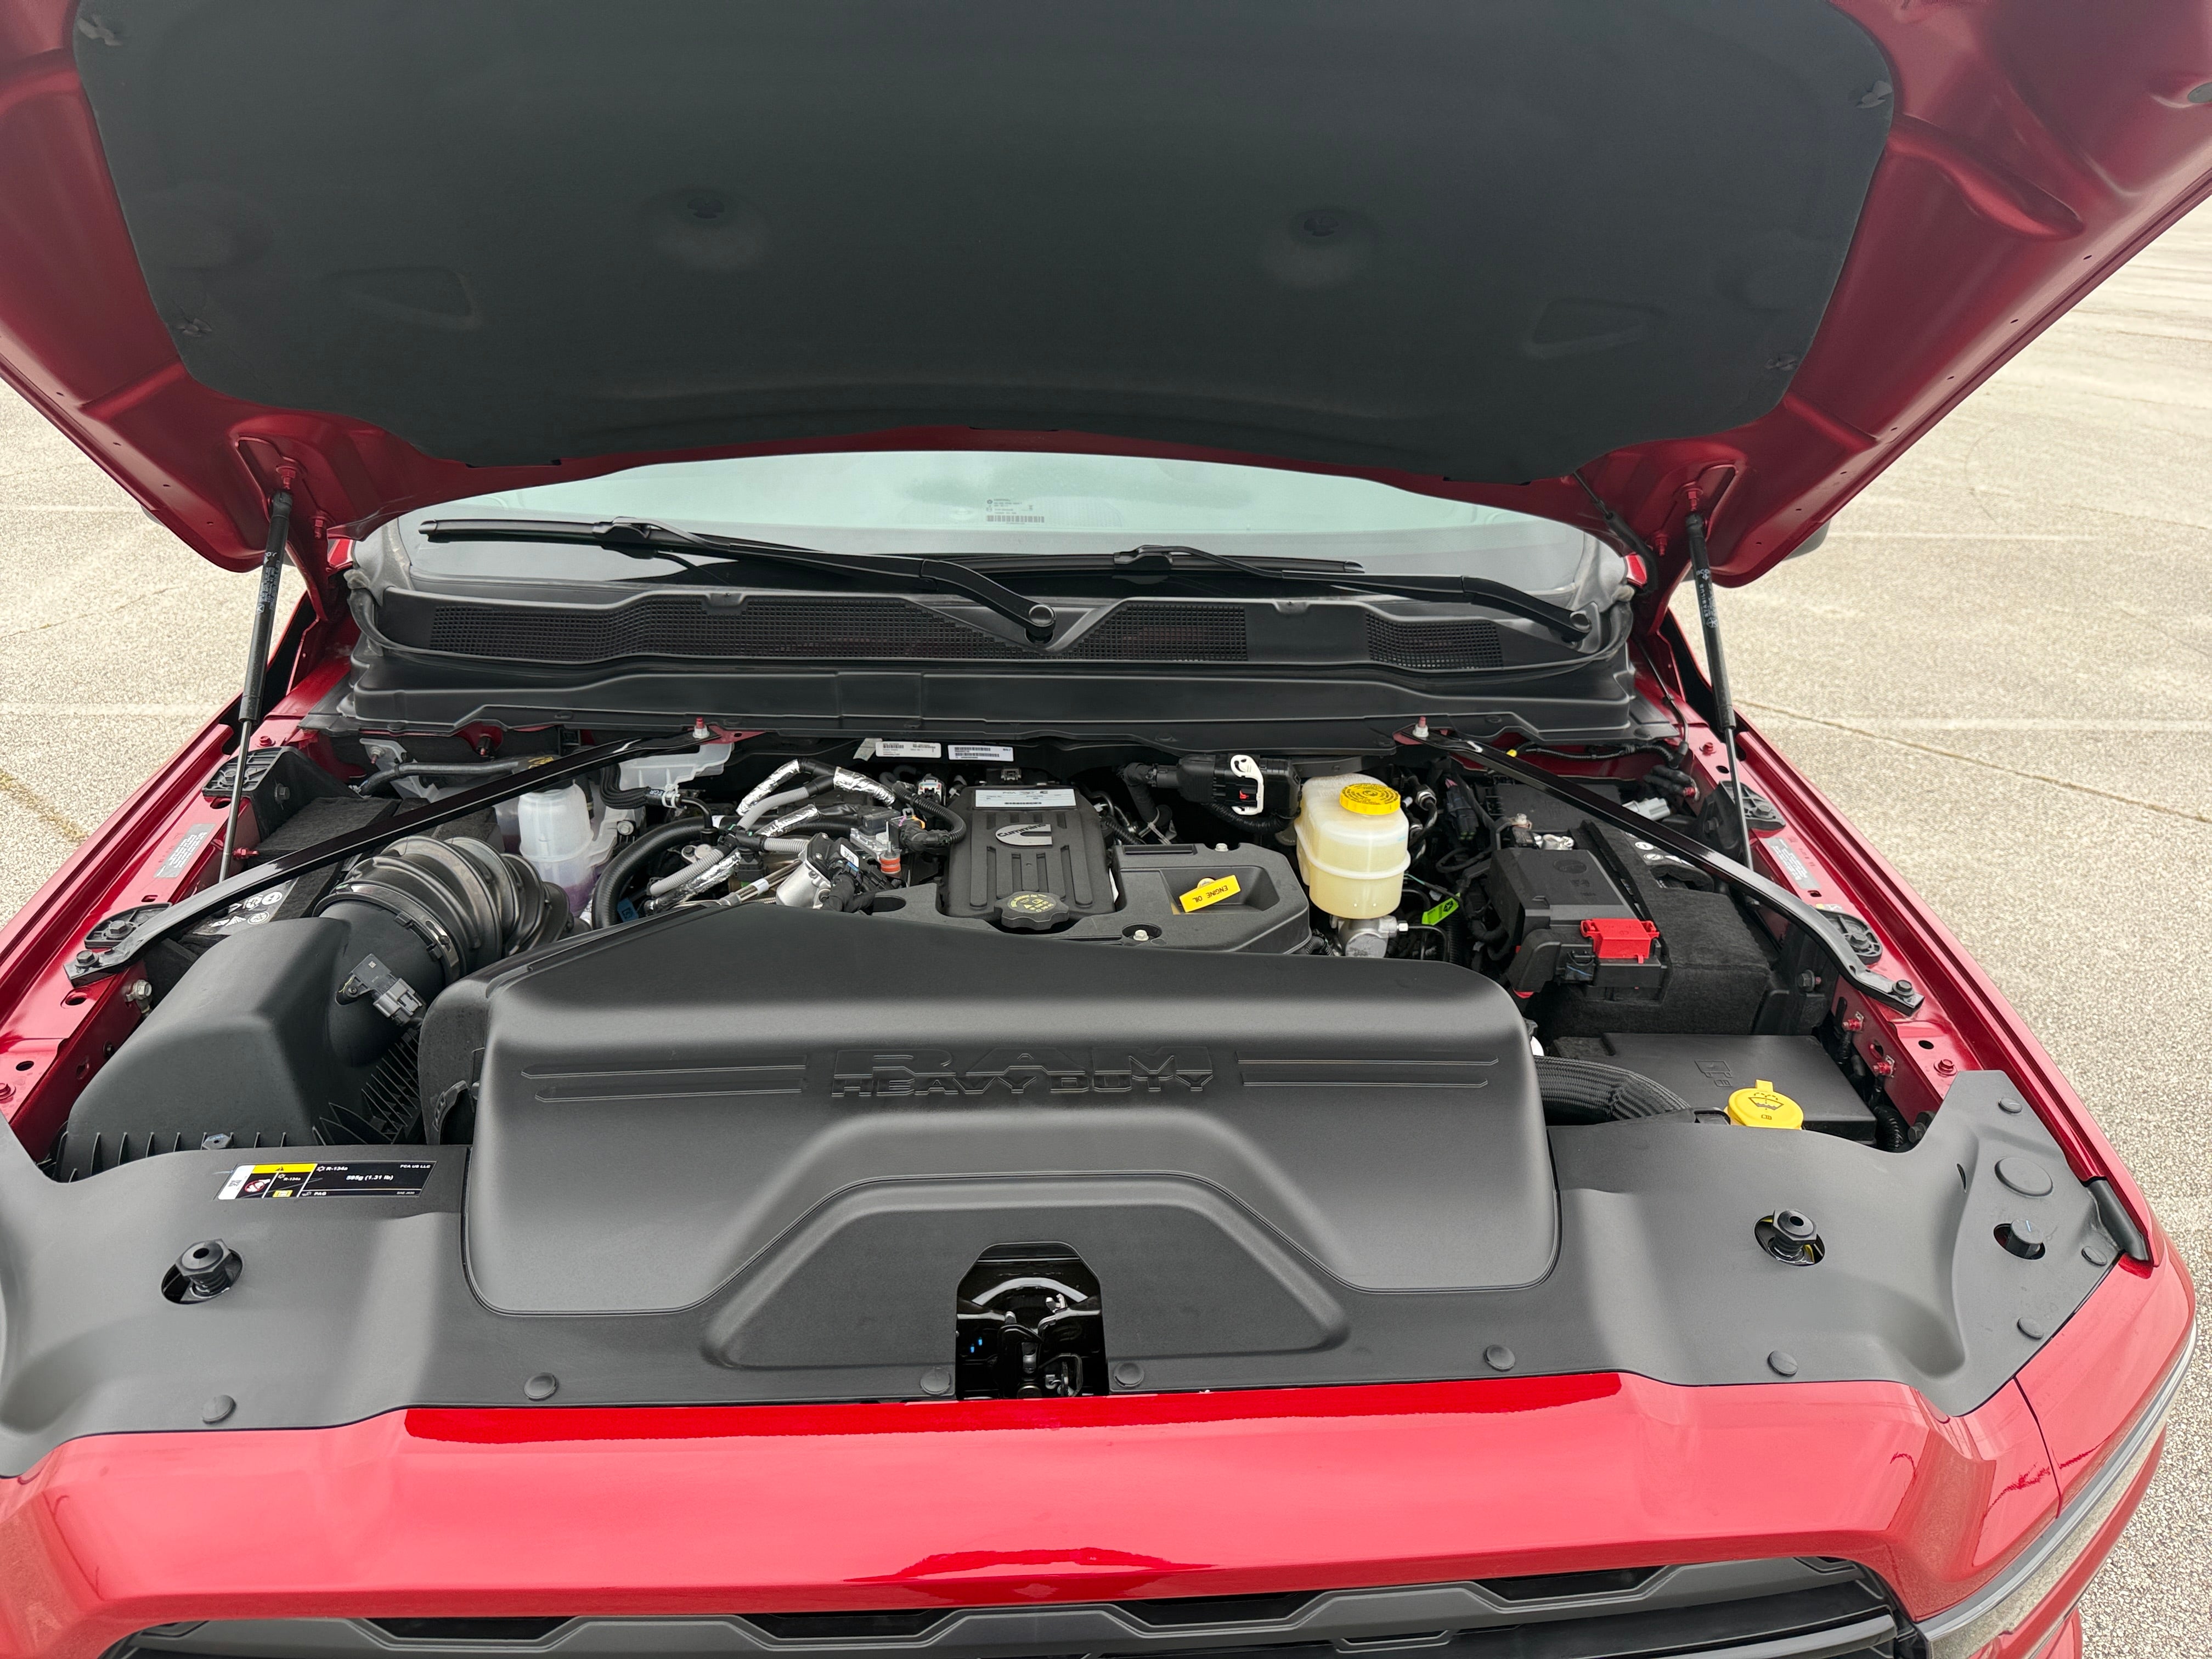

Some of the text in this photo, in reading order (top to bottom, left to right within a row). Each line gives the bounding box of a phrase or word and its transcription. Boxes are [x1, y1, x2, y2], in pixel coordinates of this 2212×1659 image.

[997, 823, 1047, 837] Cummins
[1205, 885, 1228, 899] ENGINE
[833, 1047, 1213, 1079] RAM
[831, 1073, 1215, 1097] HEAVY DUTY
